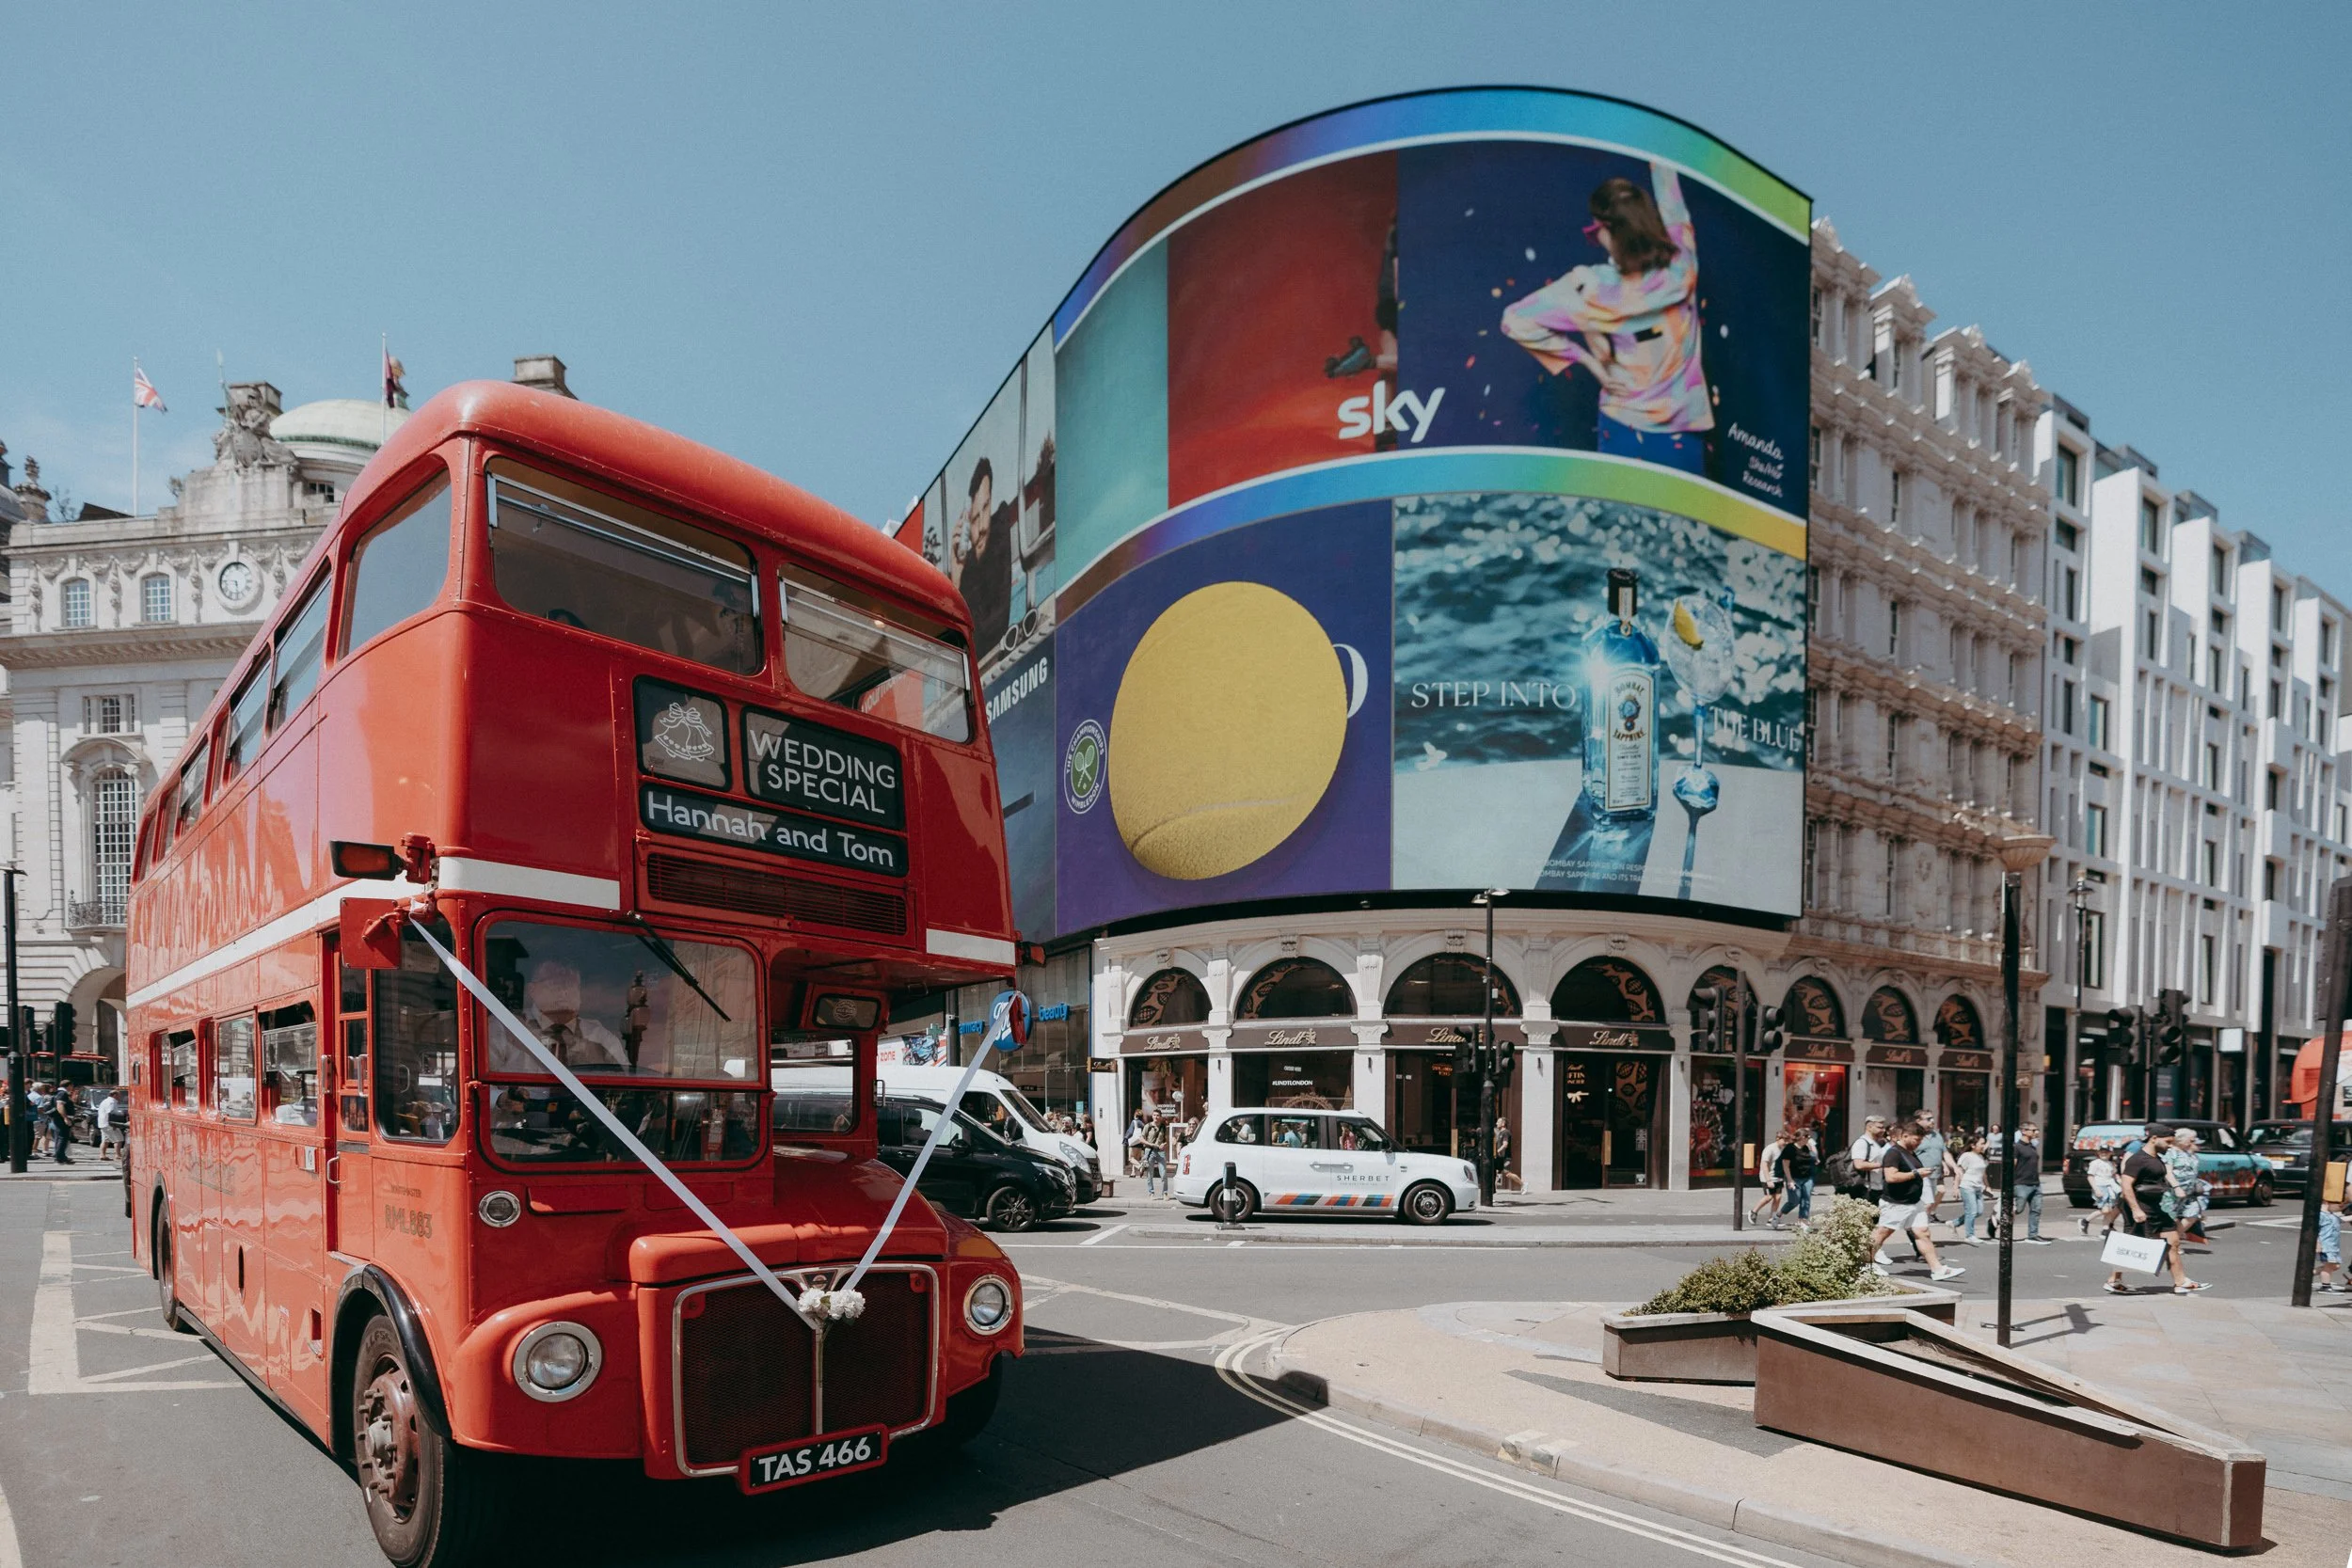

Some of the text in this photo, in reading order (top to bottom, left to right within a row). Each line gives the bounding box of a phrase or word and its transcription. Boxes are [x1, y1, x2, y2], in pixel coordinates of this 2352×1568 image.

[1338, 380, 1446, 443] sky
[985, 657, 1048, 725] SAMSUNG
[1411, 680, 1577, 709] STEP INTO
[1071, 724, 1104, 756] CHAMPIONSHIPS
[1708, 705, 1801, 752] THE BLUE
[750, 729, 896, 788] WEDDING
[767, 764, 885, 815] SPECIAL
[1071, 783, 1100, 809] WIMBLEDON
[647, 790, 895, 868] Hannah and Tom
[959, 1021, 984, 1034] armacy
[1039, 1001, 1070, 1022] beauty
[1144, 1037, 1172, 1051] Lindt
[1264, 1030, 1306, 1046] Lindt
[1589, 1030, 1629, 1046] Lindt
[757, 1436, 871, 1482] TAS 466
